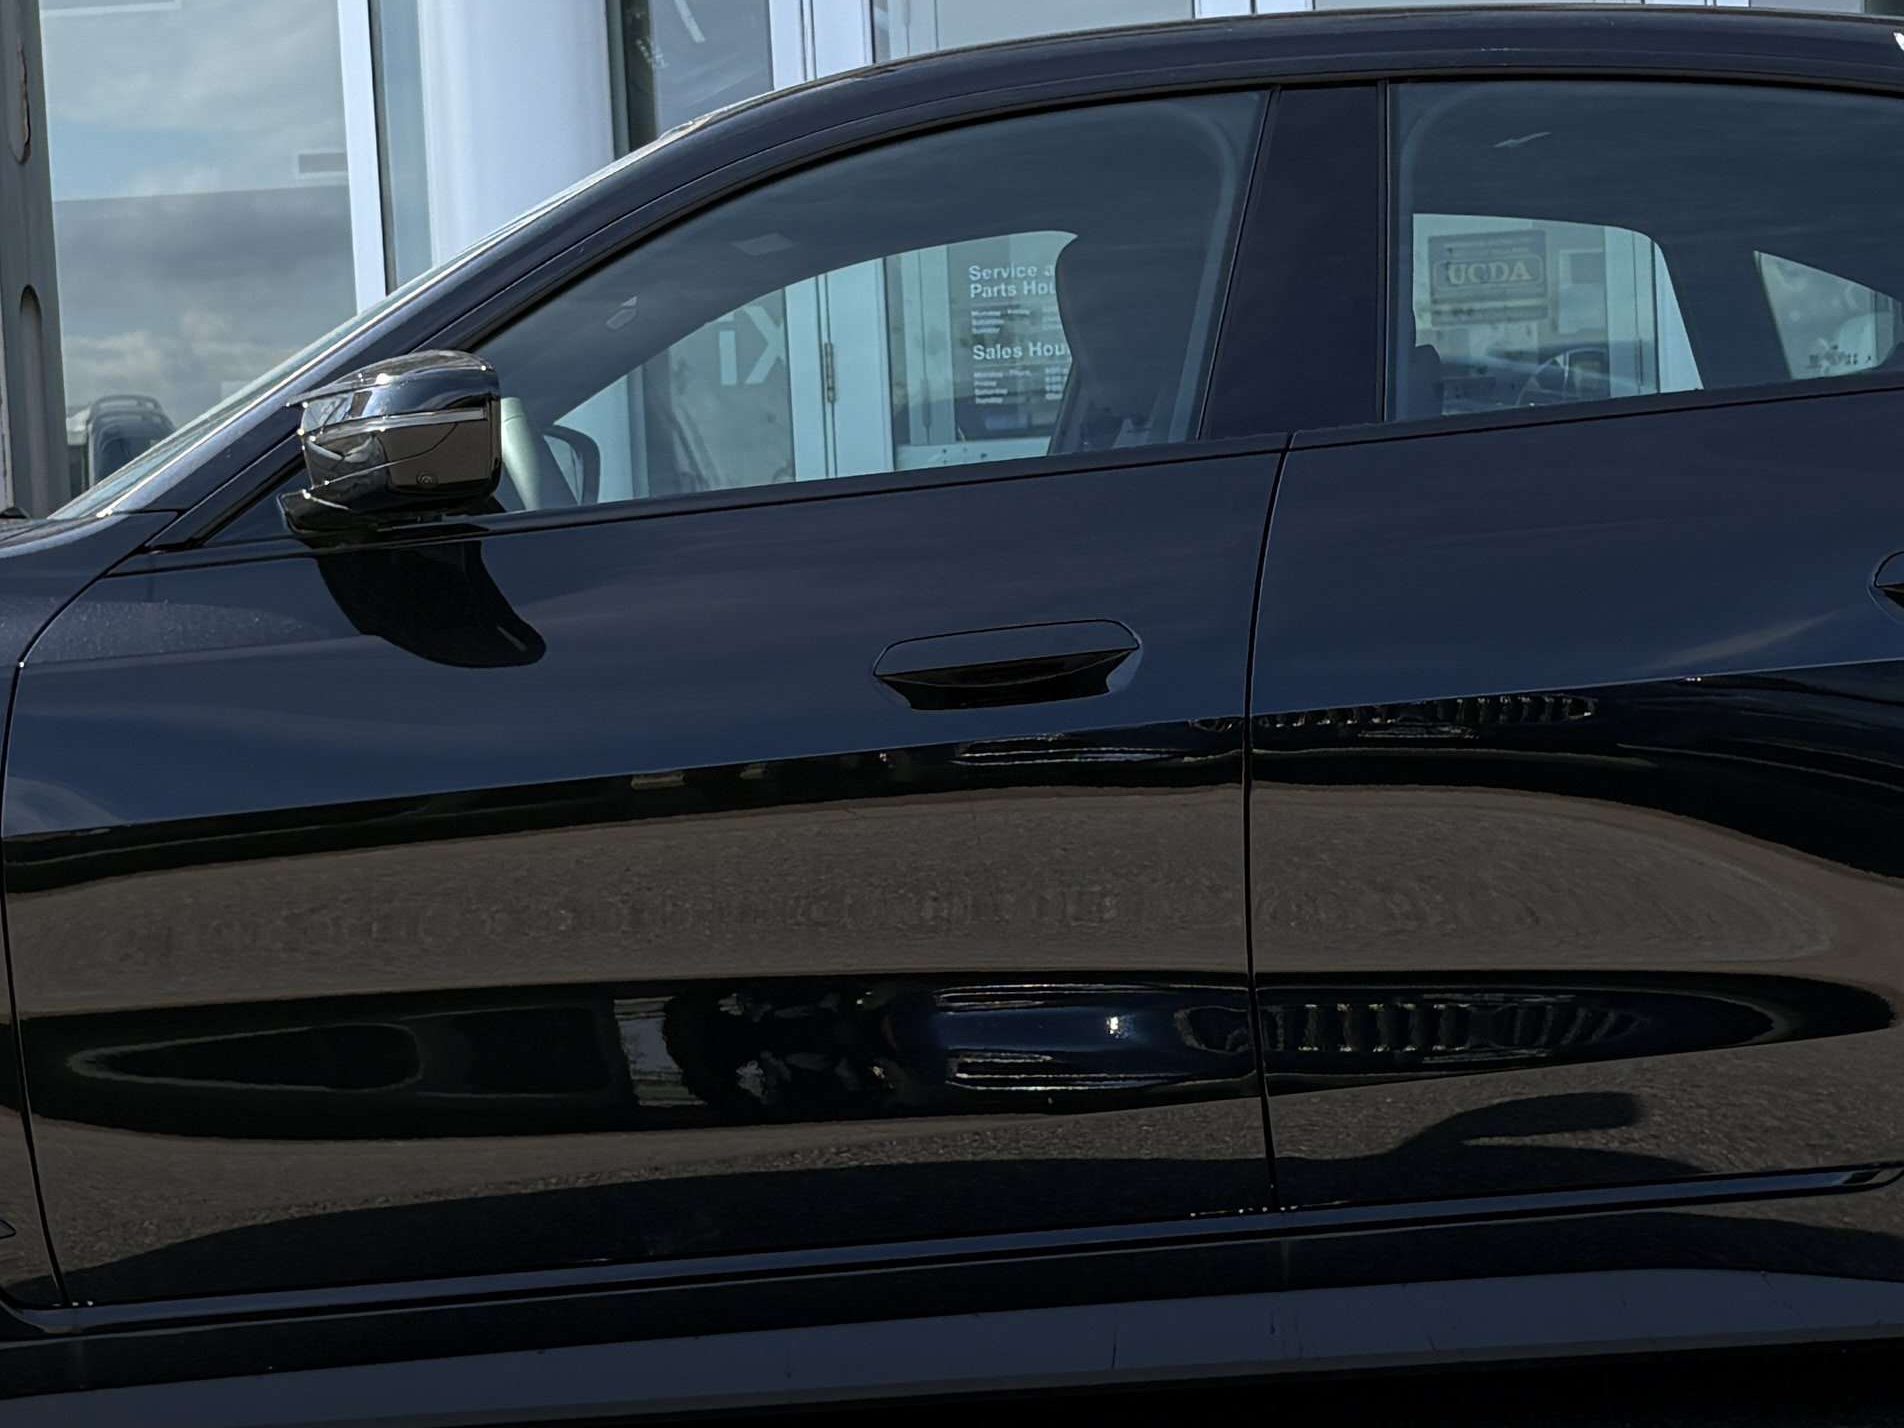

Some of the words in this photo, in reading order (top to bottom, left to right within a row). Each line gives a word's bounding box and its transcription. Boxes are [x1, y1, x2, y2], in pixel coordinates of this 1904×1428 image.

[968, 262, 1038, 281] Service
[1447, 260, 1533, 285] UCDA
[969, 282, 1017, 299] Parts
[972, 343, 1023, 360] Sales
[1028, 341, 1065, 357] Hou
